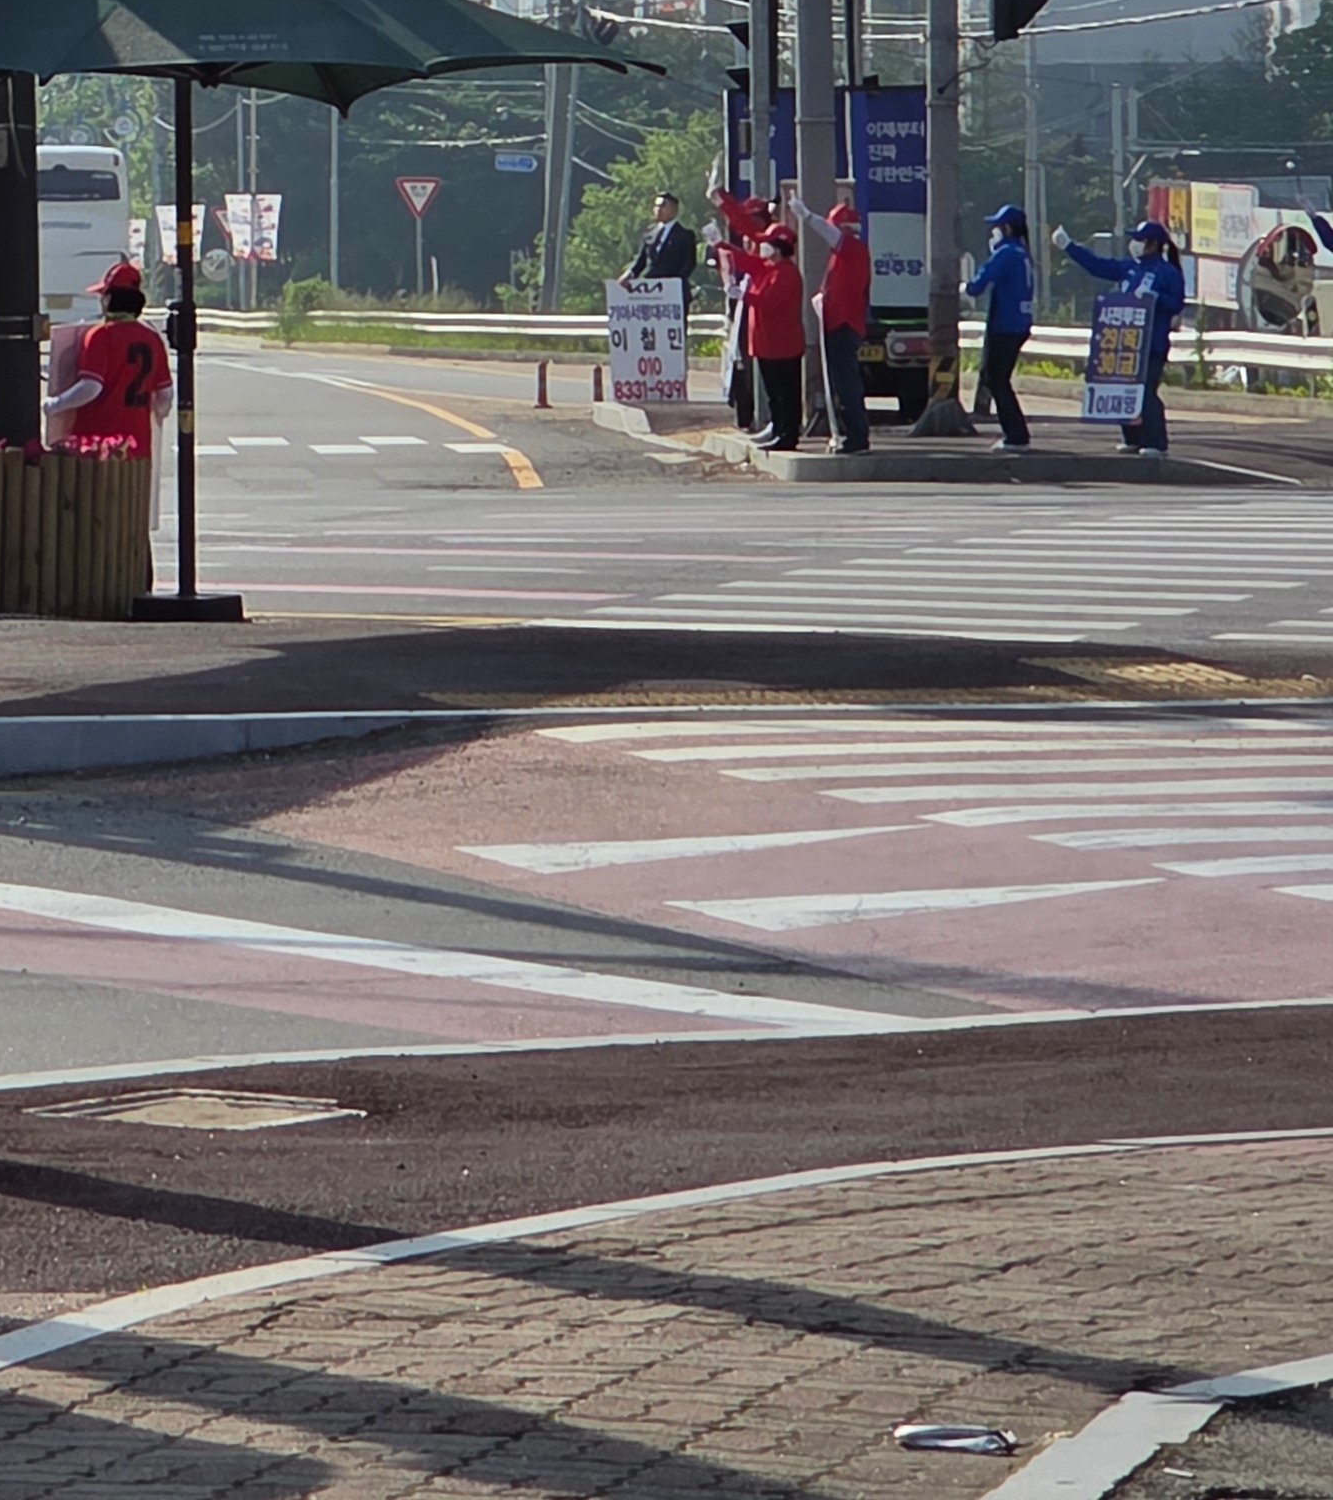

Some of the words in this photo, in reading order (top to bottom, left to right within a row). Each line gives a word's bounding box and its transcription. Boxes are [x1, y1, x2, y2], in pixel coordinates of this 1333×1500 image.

[874, 258, 924, 277] 민주당
[124, 340, 153, 408] 2
[637, 356, 663, 377] 010
